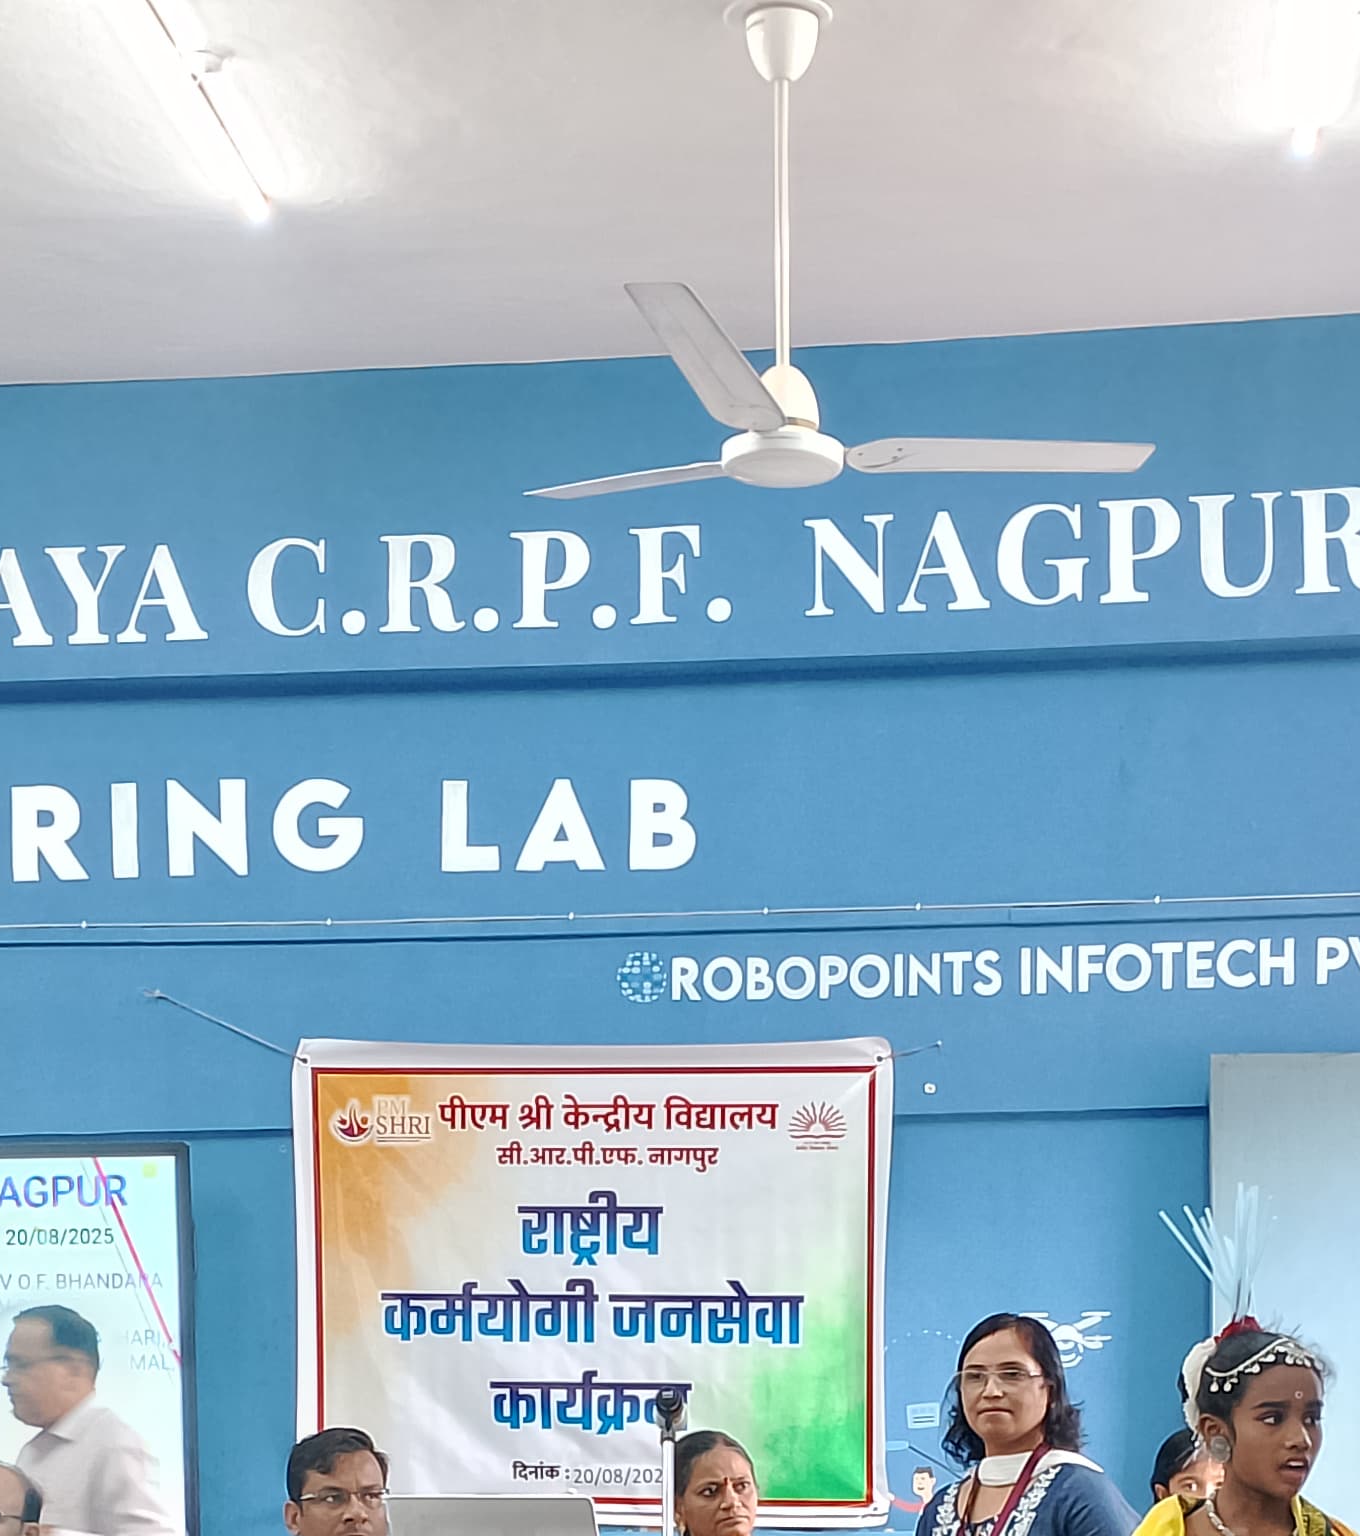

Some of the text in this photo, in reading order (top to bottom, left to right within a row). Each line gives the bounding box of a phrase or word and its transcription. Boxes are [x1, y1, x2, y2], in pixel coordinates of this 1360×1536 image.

[247, 523, 733, 637] C.R.P.F.
[440, 777, 699, 872] LAB
[671, 950, 1003, 1002] ROBOPOINTS
[1019, 937, 1296, 996] INFOTECH
[376, 1100, 408, 1115] PM
[376, 1114, 431, 1136] SHRI
[439, 1093, 779, 1133] पीएम श्री केन्द्रीय विद्यालय
[496, 1143, 720, 1172] सी.आर.पी.एफ. नागपुर
[5, 1227, 115, 1246] 20/08/2025
[517, 1190, 664, 1266] राष्ट्रीय
[381, 1278, 805, 1344] कर्मयोगी जनसेवा
[512, 1460, 561, 1481] दिनांक
[573, 1467, 663, 1486] 20/08/202
